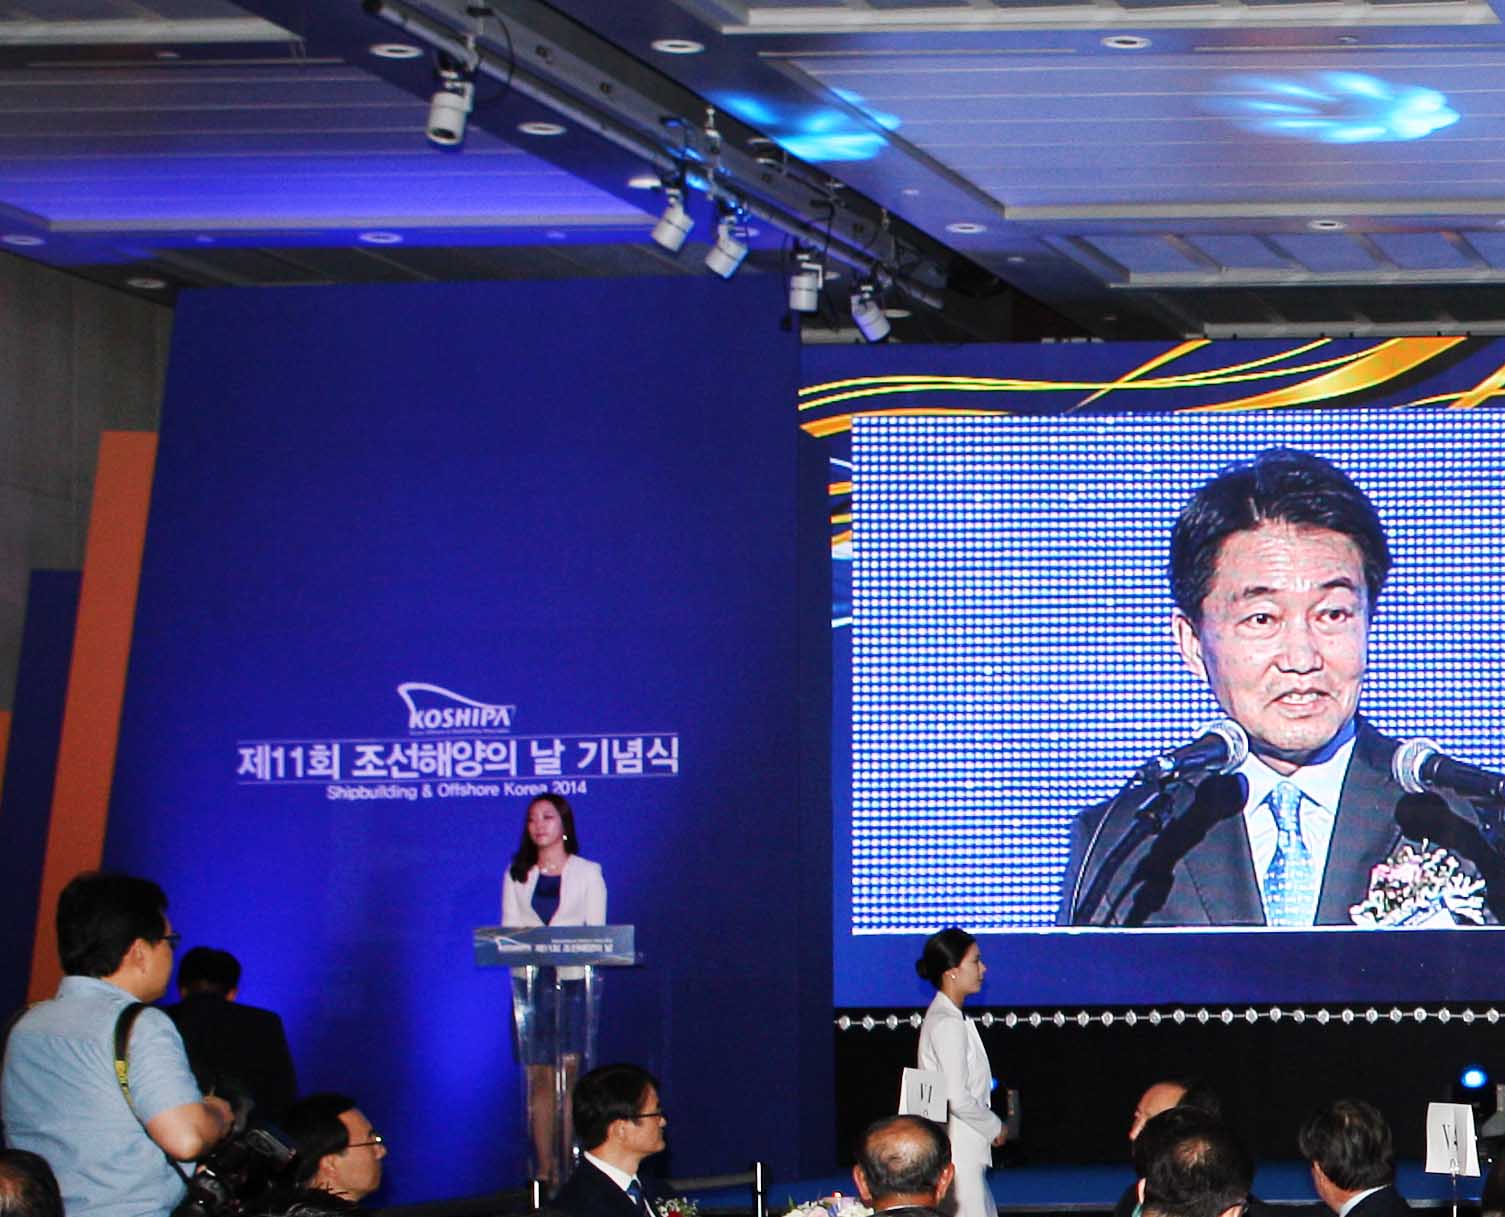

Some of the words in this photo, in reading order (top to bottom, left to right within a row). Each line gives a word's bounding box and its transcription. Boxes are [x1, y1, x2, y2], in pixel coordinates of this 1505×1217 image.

[409, 707, 511, 729] KOSHIPA
[237, 742, 341, 780] 제11회
[352, 738, 517, 780] 조선해양의
[529, 738, 566, 776] 날
[577, 735, 680, 776] 기념식
[326, 784, 418, 801] Shipbuilding
[422, 783, 433, 798] &
[437, 781, 500, 798] Offshore
[503, 781, 548, 797] Korea
[552, 779, 588, 795] 2014
